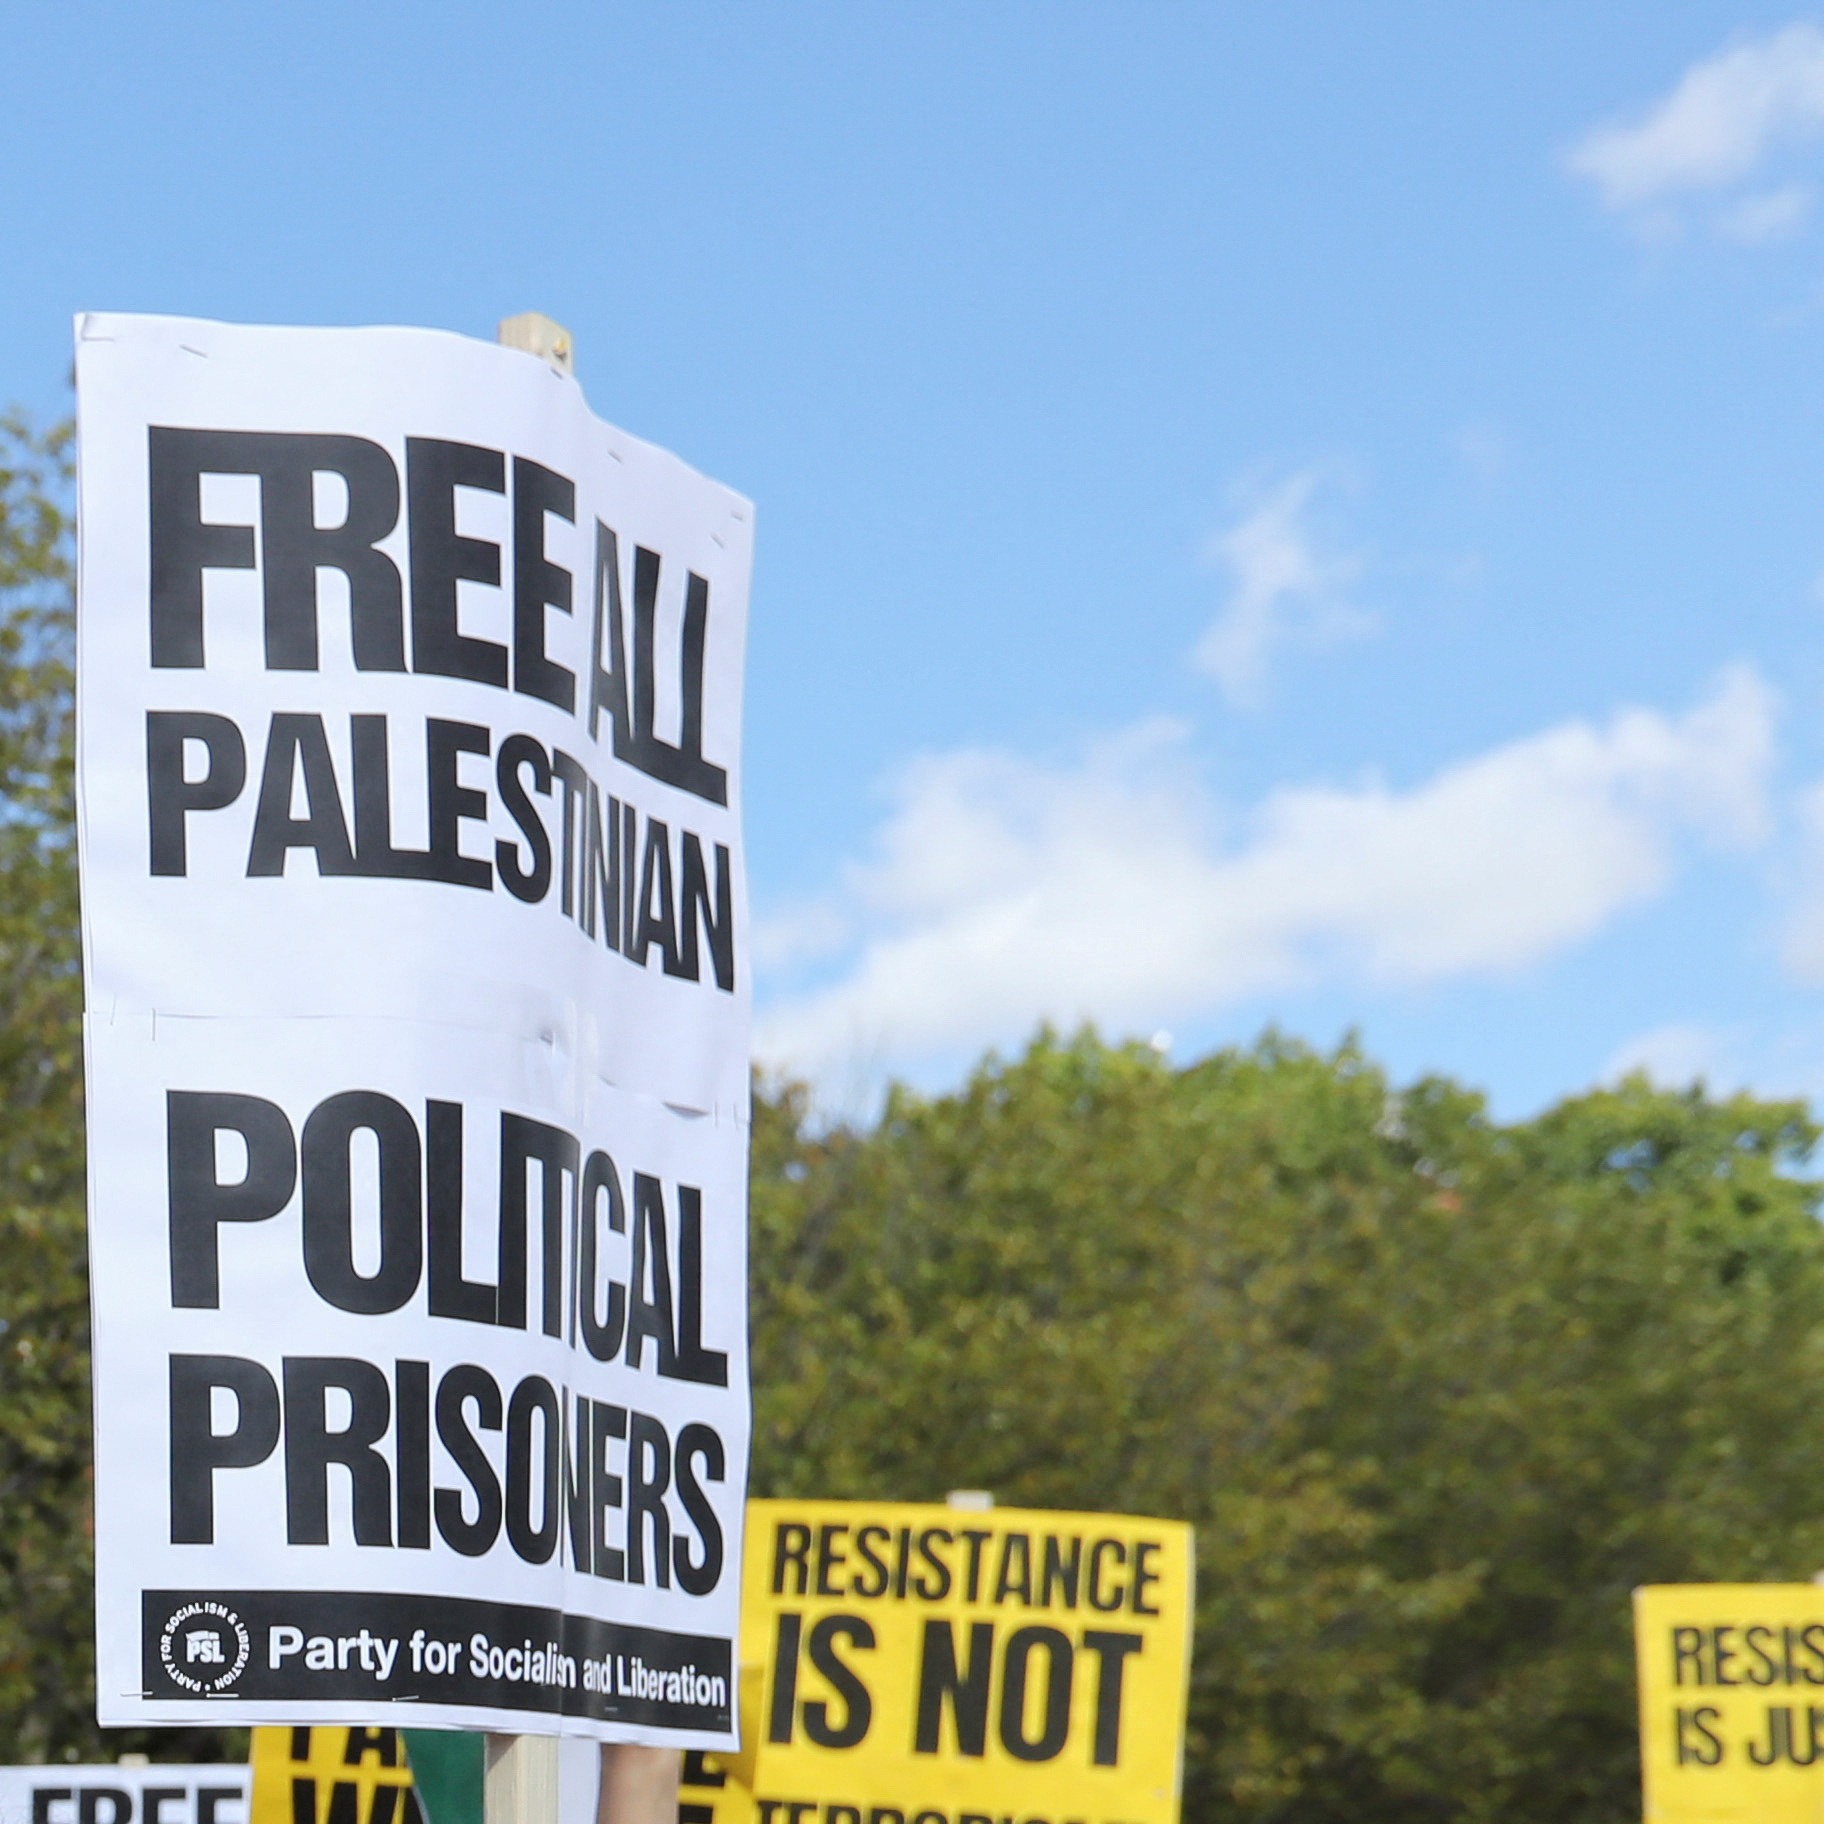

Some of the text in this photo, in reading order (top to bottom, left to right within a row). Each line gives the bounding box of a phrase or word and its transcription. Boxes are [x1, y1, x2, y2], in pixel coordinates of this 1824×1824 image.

[148, 424, 728, 808] FREE ALL
[145, 708, 736, 994] PALESTINIAN
[165, 1089, 729, 1388] POLITICAL
[168, 1352, 727, 1597] PRISONERS
[771, 1522, 1162, 1618] RESISTANCE
[160, 1602, 250, 1692] PARTY FOR SOCIALISM & LIBERATION
[186, 1638, 225, 1663] PSL
[269, 1626, 726, 1708] Party for Socialism and Liberation
[767, 1611, 1145, 1768] IS NOT
[1675, 1706, 1824, 1767] IS JU
